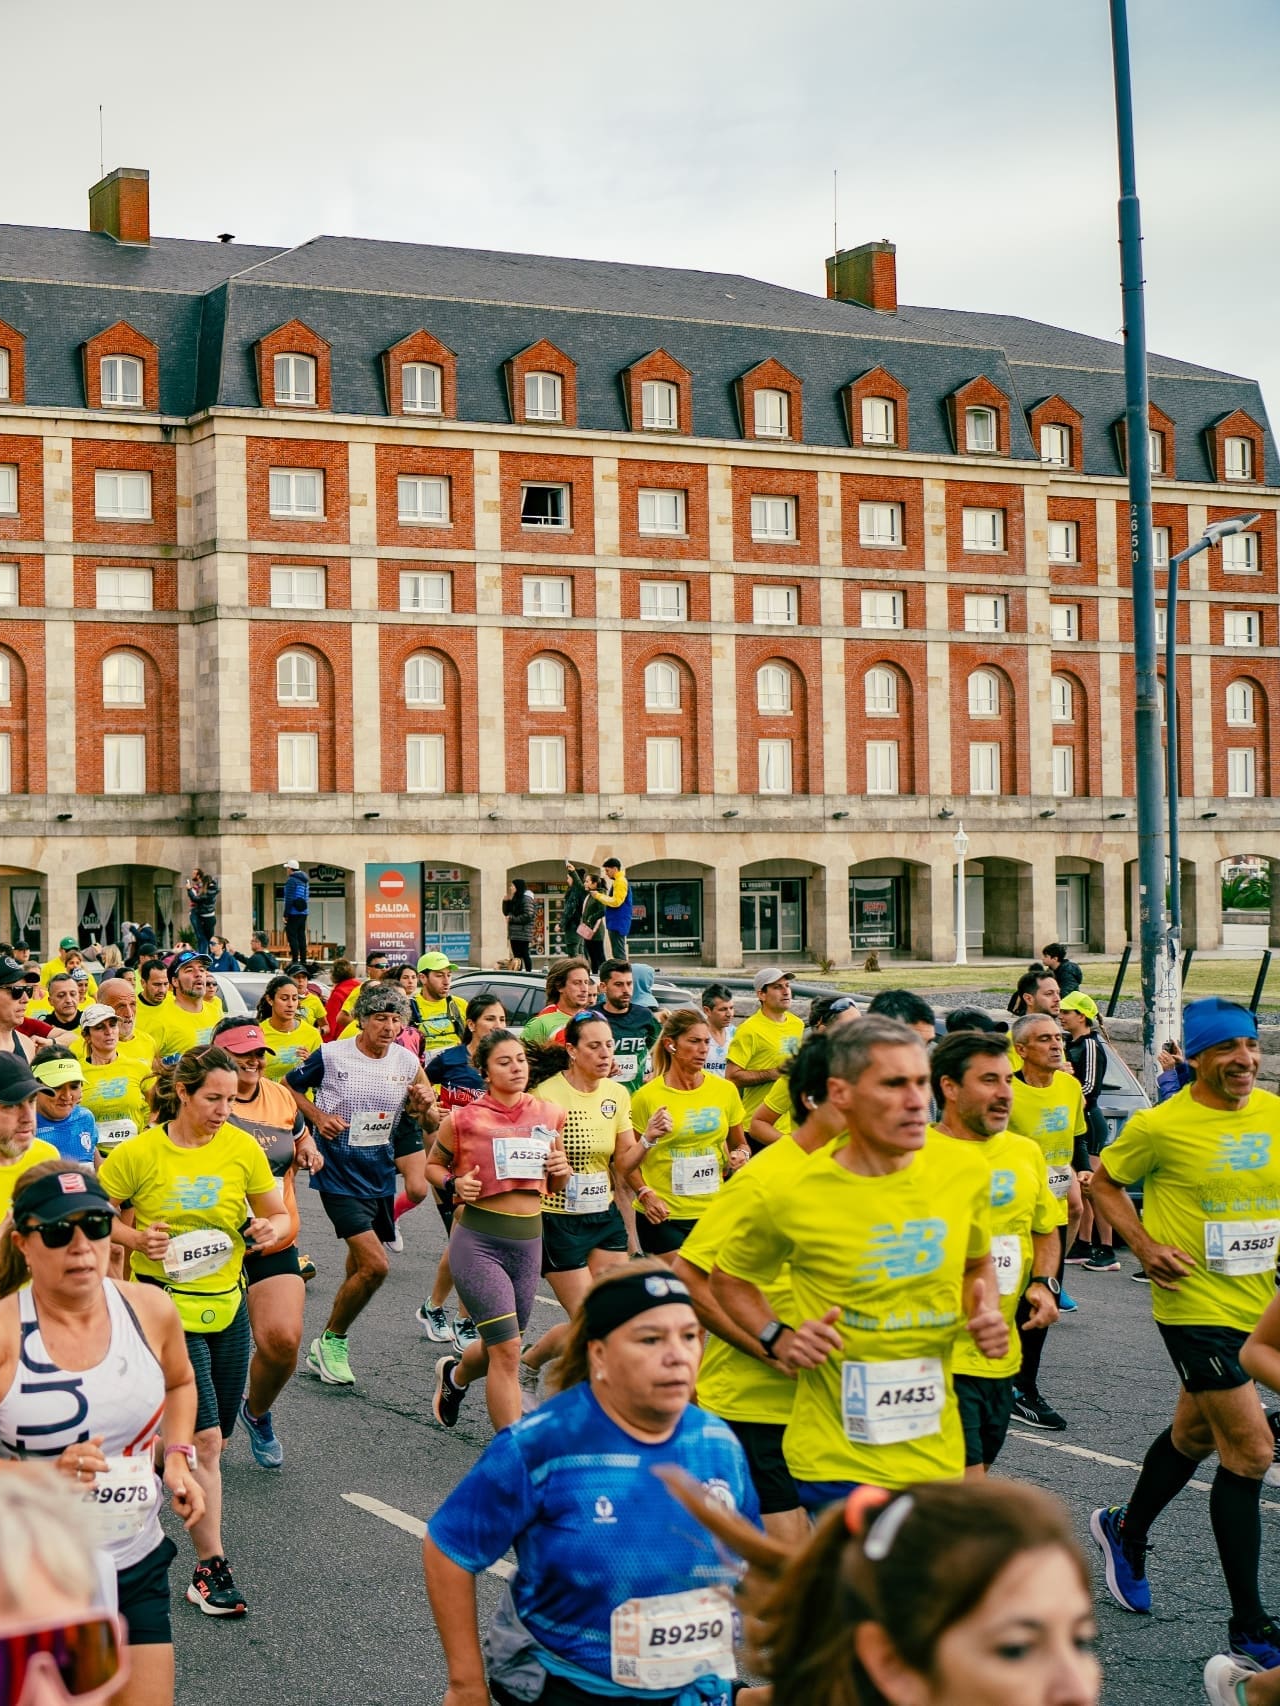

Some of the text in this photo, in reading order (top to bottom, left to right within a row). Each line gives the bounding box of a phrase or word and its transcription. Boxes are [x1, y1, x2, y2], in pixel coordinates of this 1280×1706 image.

[1130, 504, 1139, 563] 2650
[374, 904, 410, 912] SALIDA
[370, 931, 414, 939] HERMITAGE
[379, 940, 406, 948] HOTEL
[108, 1130, 130, 1139] A619
[692, 1167, 714, 1179] A161
[991, 1170, 1016, 1207] B
[183, 1242, 228, 1262] B6335
[1229, 1236, 1275, 1252] A3583
[992, 1256, 1012, 1268] 18
[848, 1367, 864, 1398] A
[876, 1385, 934, 1406] A1433
[196, 1580, 211, 1600] FILA
[648, 1618, 724, 1646] B9250
